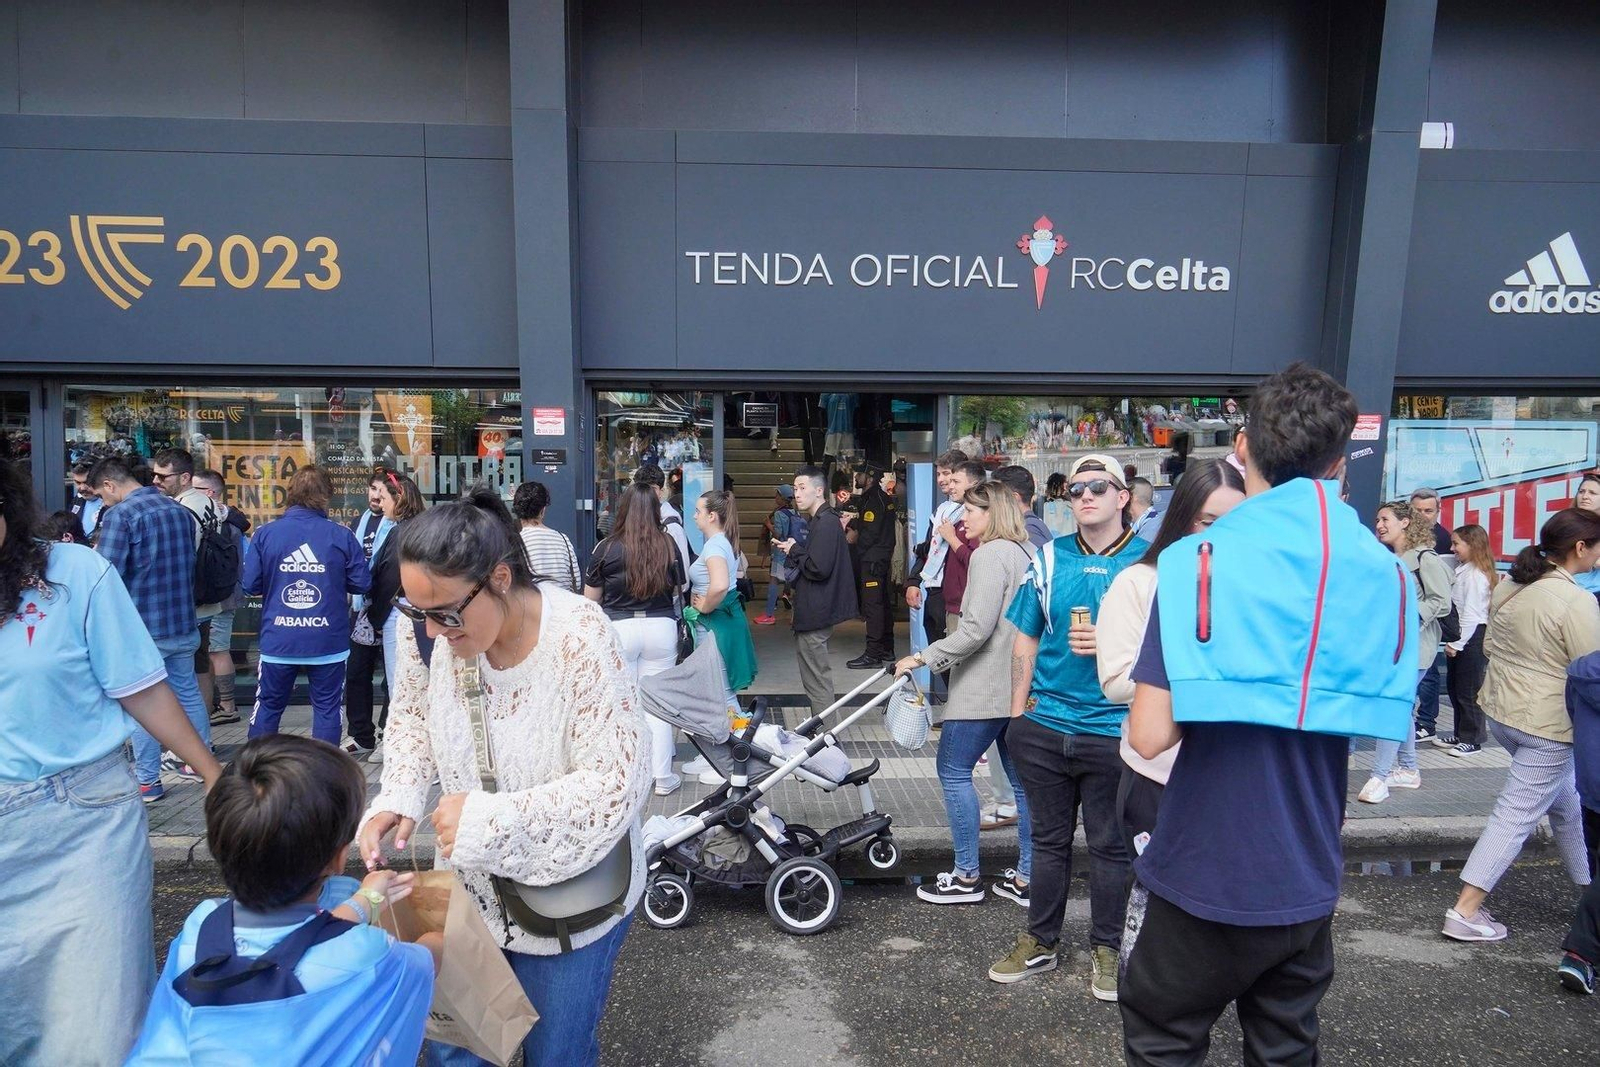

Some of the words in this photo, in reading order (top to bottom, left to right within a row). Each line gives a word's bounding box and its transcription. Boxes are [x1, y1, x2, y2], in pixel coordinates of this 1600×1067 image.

[176, 233, 342, 291] 2023
[685, 251, 834, 286] TENDA
[850, 253, 1018, 288] OFICIAL
[1489, 284, 1600, 314] adidas
[195, 409, 225, 420] CELTA
[222, 455, 298, 480] FESTA
[328, 508, 360, 517] BATEA
[280, 561, 326, 573] adidas
[1083, 566, 1108, 575] adidas
[287, 588, 315, 596] Estrella
[287, 595, 314, 603] Galicia
